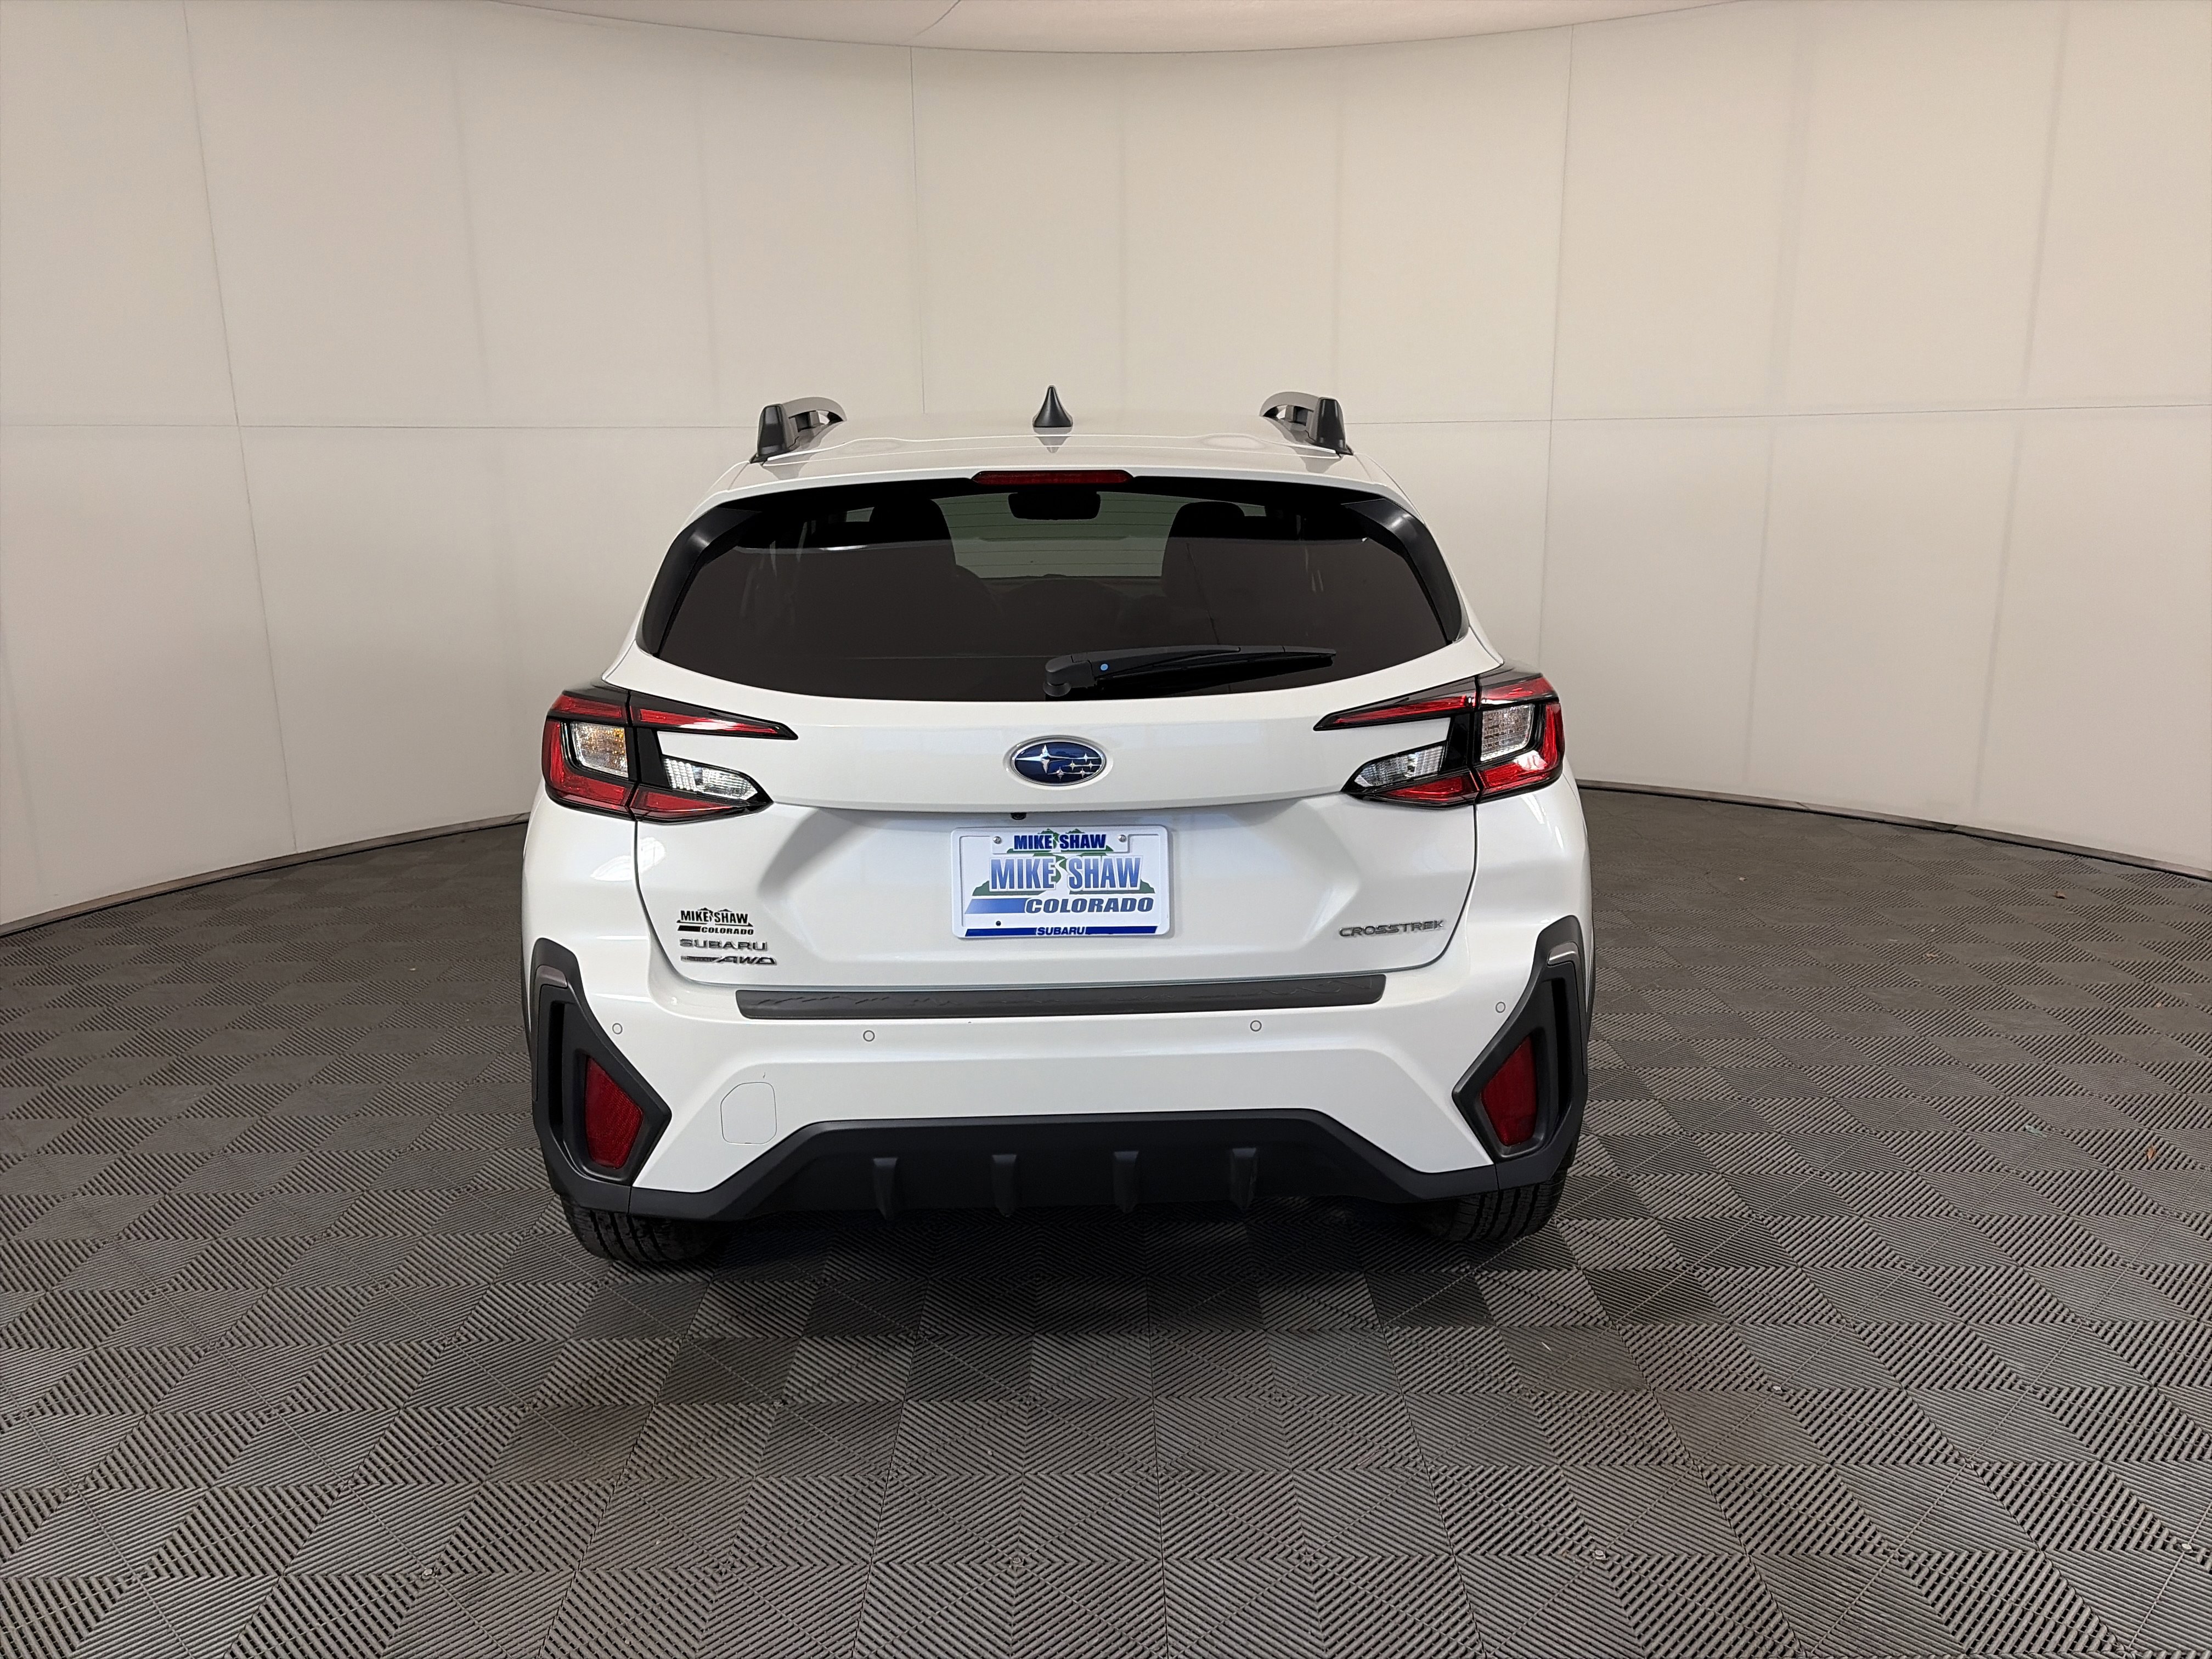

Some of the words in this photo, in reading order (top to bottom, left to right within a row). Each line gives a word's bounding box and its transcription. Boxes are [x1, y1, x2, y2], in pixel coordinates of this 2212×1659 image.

[1014, 835, 1052, 849] MIKE
[1059, 834, 1107, 849] SHAW
[991, 858, 1056, 889] MIKE
[1068, 856, 1141, 891] SHAW
[1026, 898, 1153, 913] COLORADO
[680, 910, 709, 922] MIKE
[714, 912, 748, 924] SHAW
[701, 927, 754, 935] COLORADO
[1037, 927, 1085, 935] SUBARU
[1339, 920, 1444, 938] CROSSTREK
[680, 938, 768, 951] SUBARU
[716, 956, 777, 965] AWD
